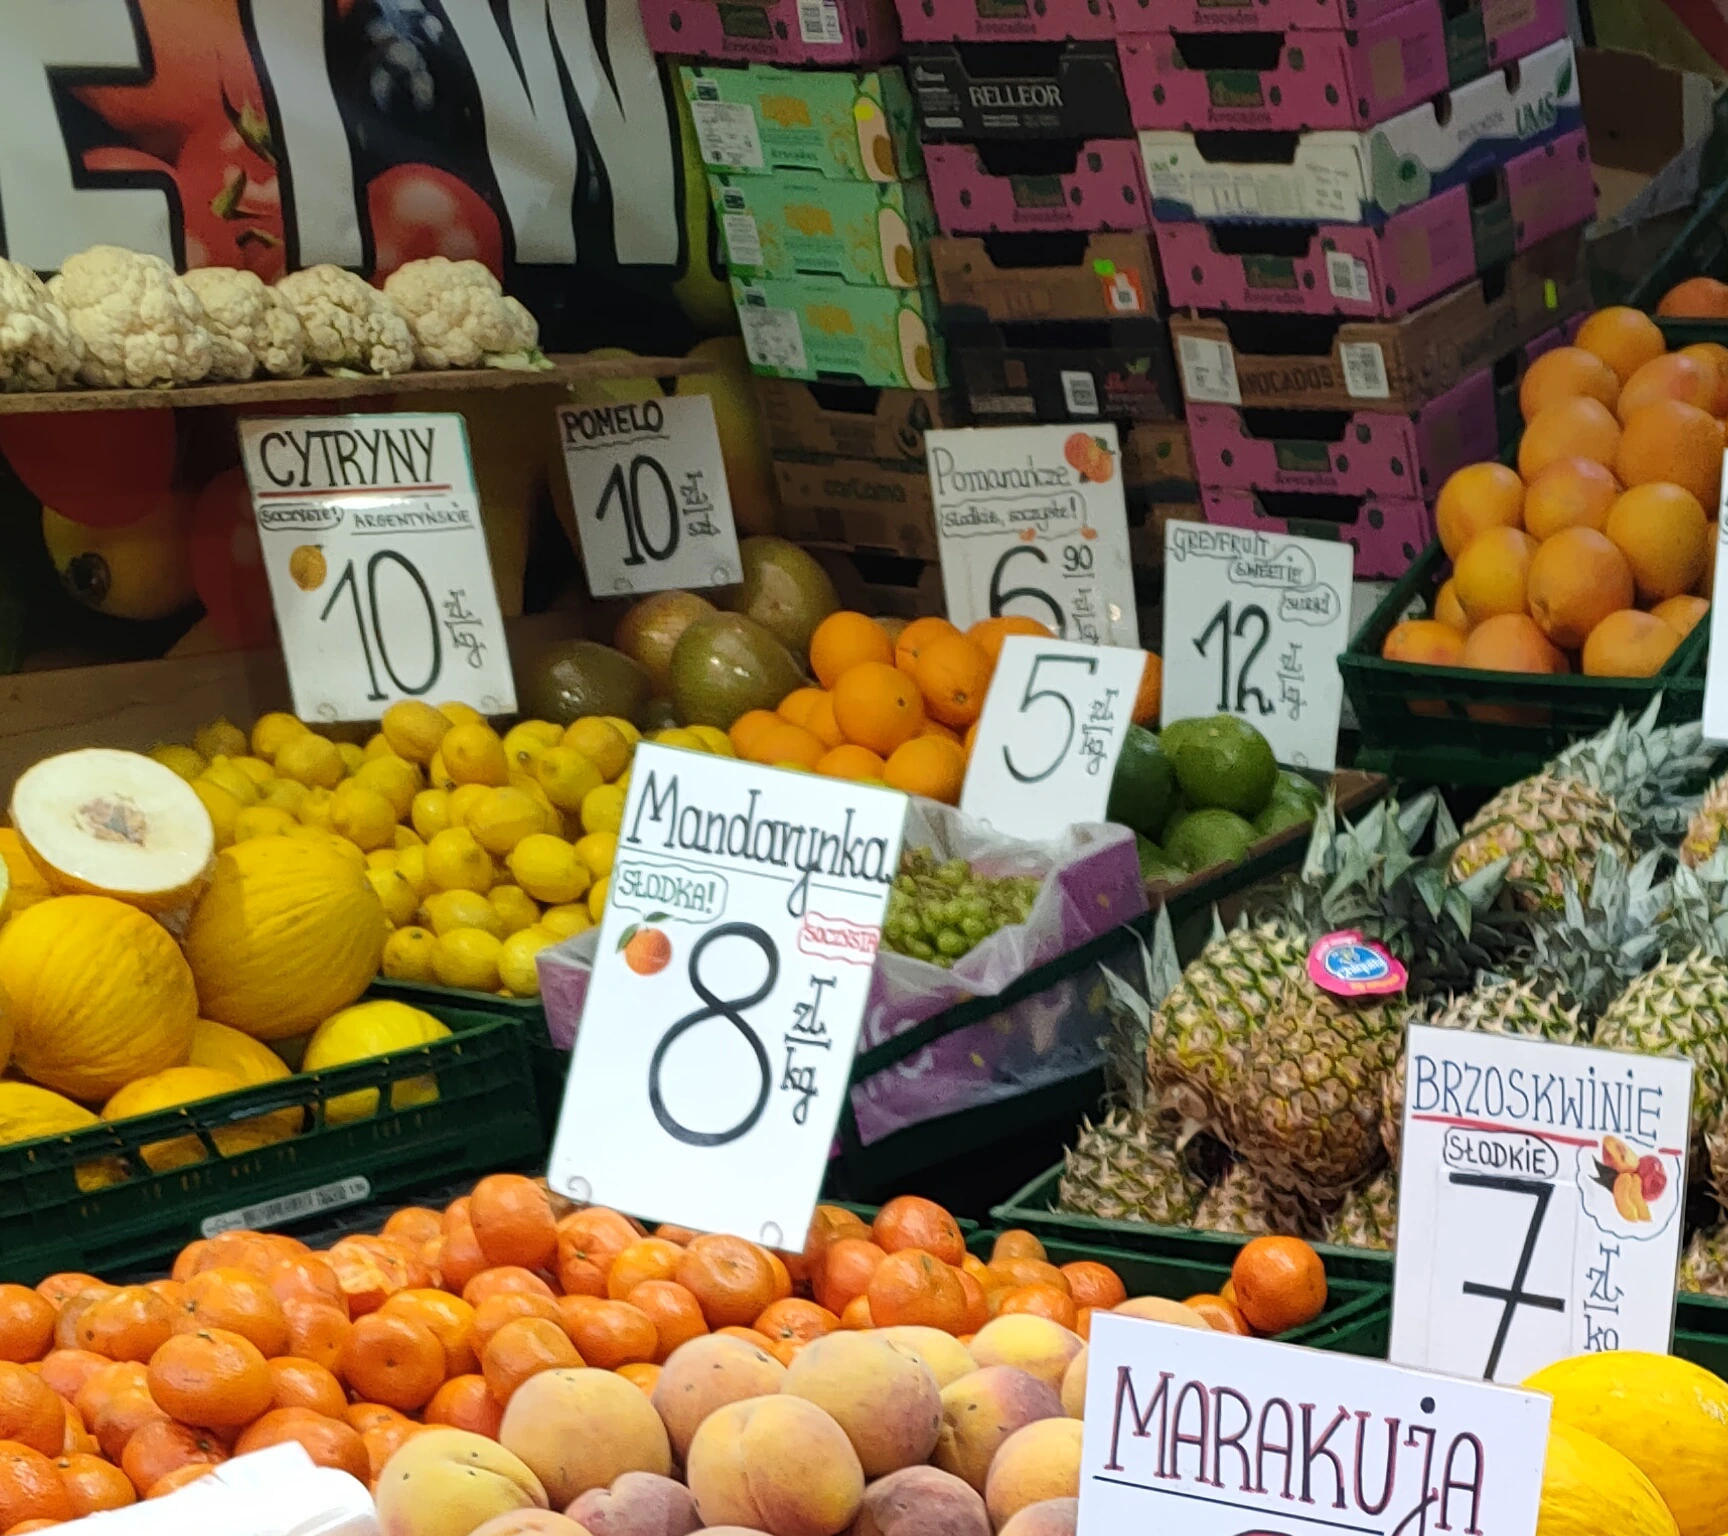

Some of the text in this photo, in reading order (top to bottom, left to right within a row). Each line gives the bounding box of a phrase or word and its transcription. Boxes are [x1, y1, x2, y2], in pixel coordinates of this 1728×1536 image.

[260, 428, 435, 487] CYTRYNY
[561, 400, 664, 443] POMELO
[596, 454, 679, 566] 10
[319, 549, 443, 701] 10
[990, 544, 1093, 639] 6 90
[1192, 600, 1275, 715] 12
[1003, 654, 1098, 784] 5
[617, 870, 716, 914] SŁODKA!
[625, 769, 893, 918] Mandarynka
[648, 921, 780, 1148] 8
[780, 1046, 818, 1126] kg
[1449, 1172, 1565, 1383] 7
